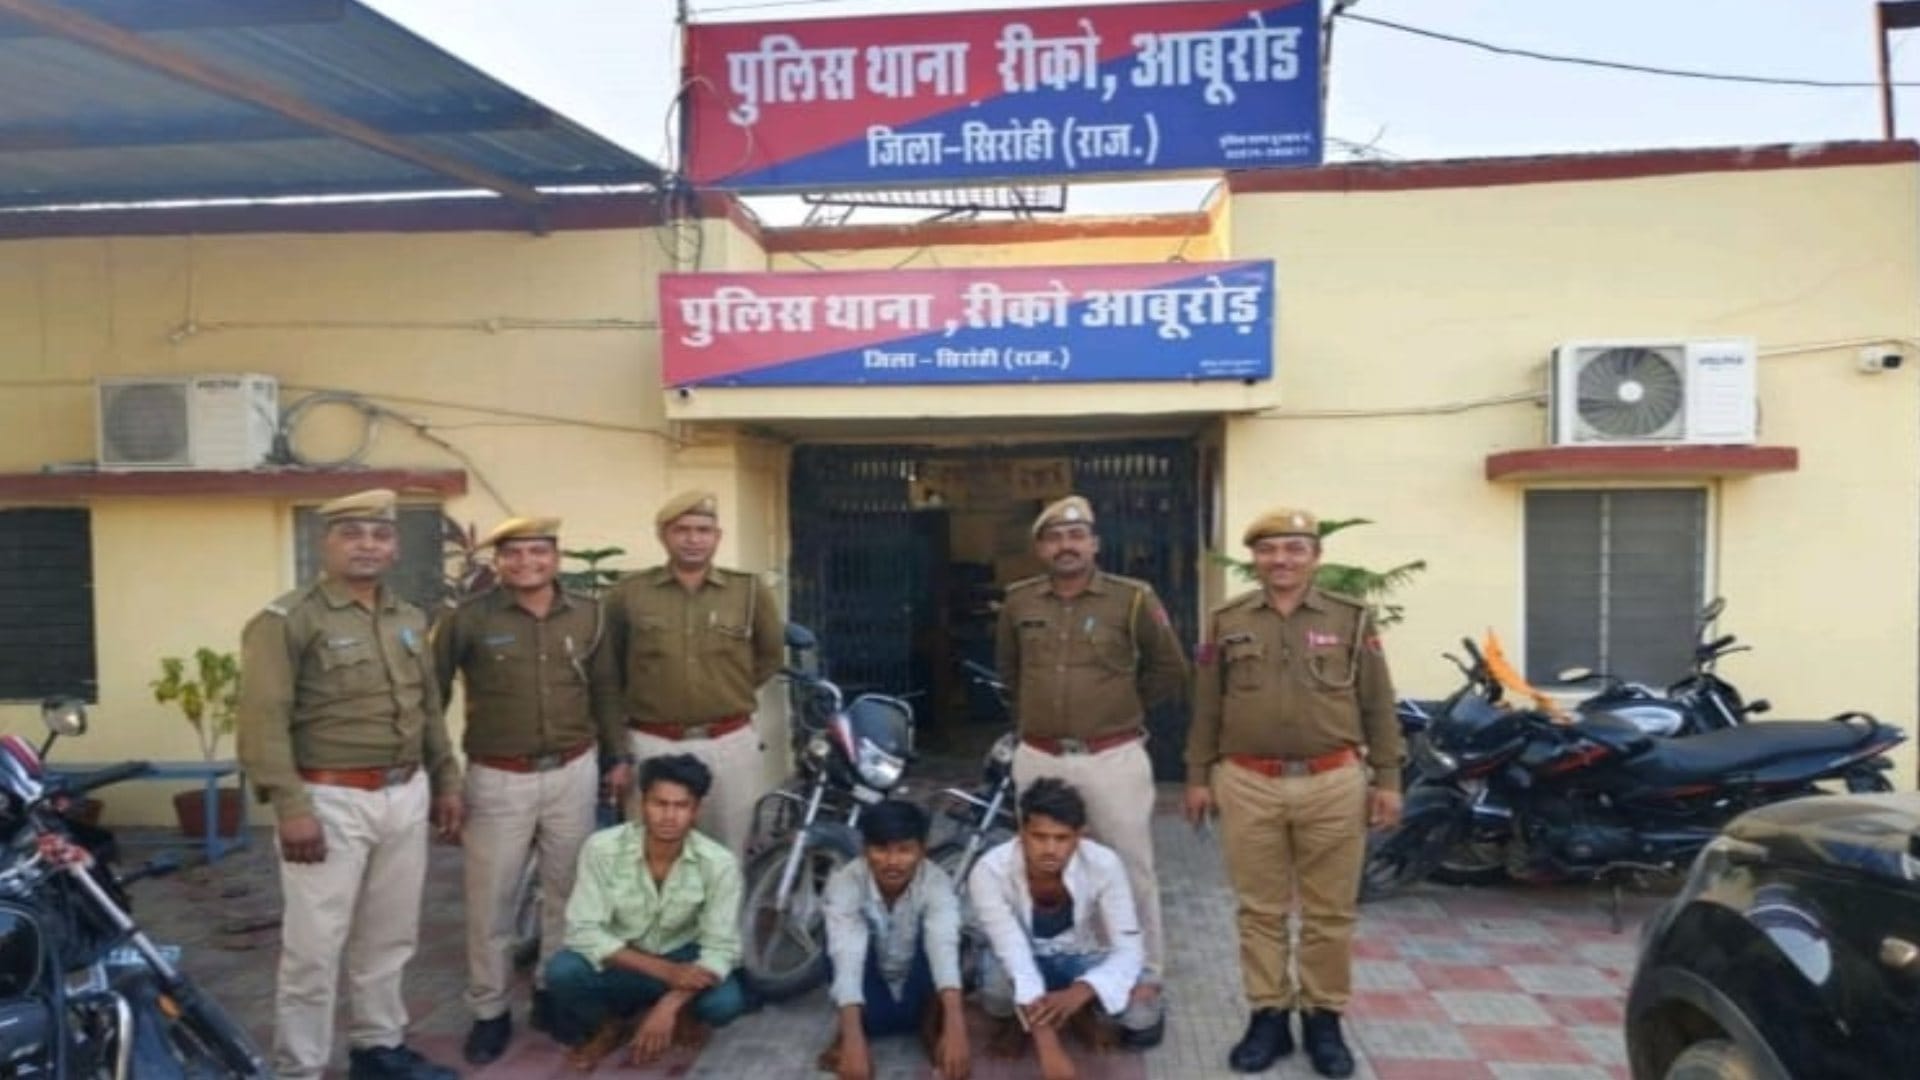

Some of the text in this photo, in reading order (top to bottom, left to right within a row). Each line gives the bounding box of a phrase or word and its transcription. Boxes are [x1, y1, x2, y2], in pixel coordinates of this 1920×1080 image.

[727, 35, 857, 127] पुलिस
[866, 43, 970, 98] थाना
[1131, 10, 1302, 104] आबूरोड
[1062, 112, 1159, 168] (राज.)
[680, 286, 816, 347] पुलिस
[824, 294, 935, 330] थाना
[1081, 275, 1261, 339] आबूरोड़
